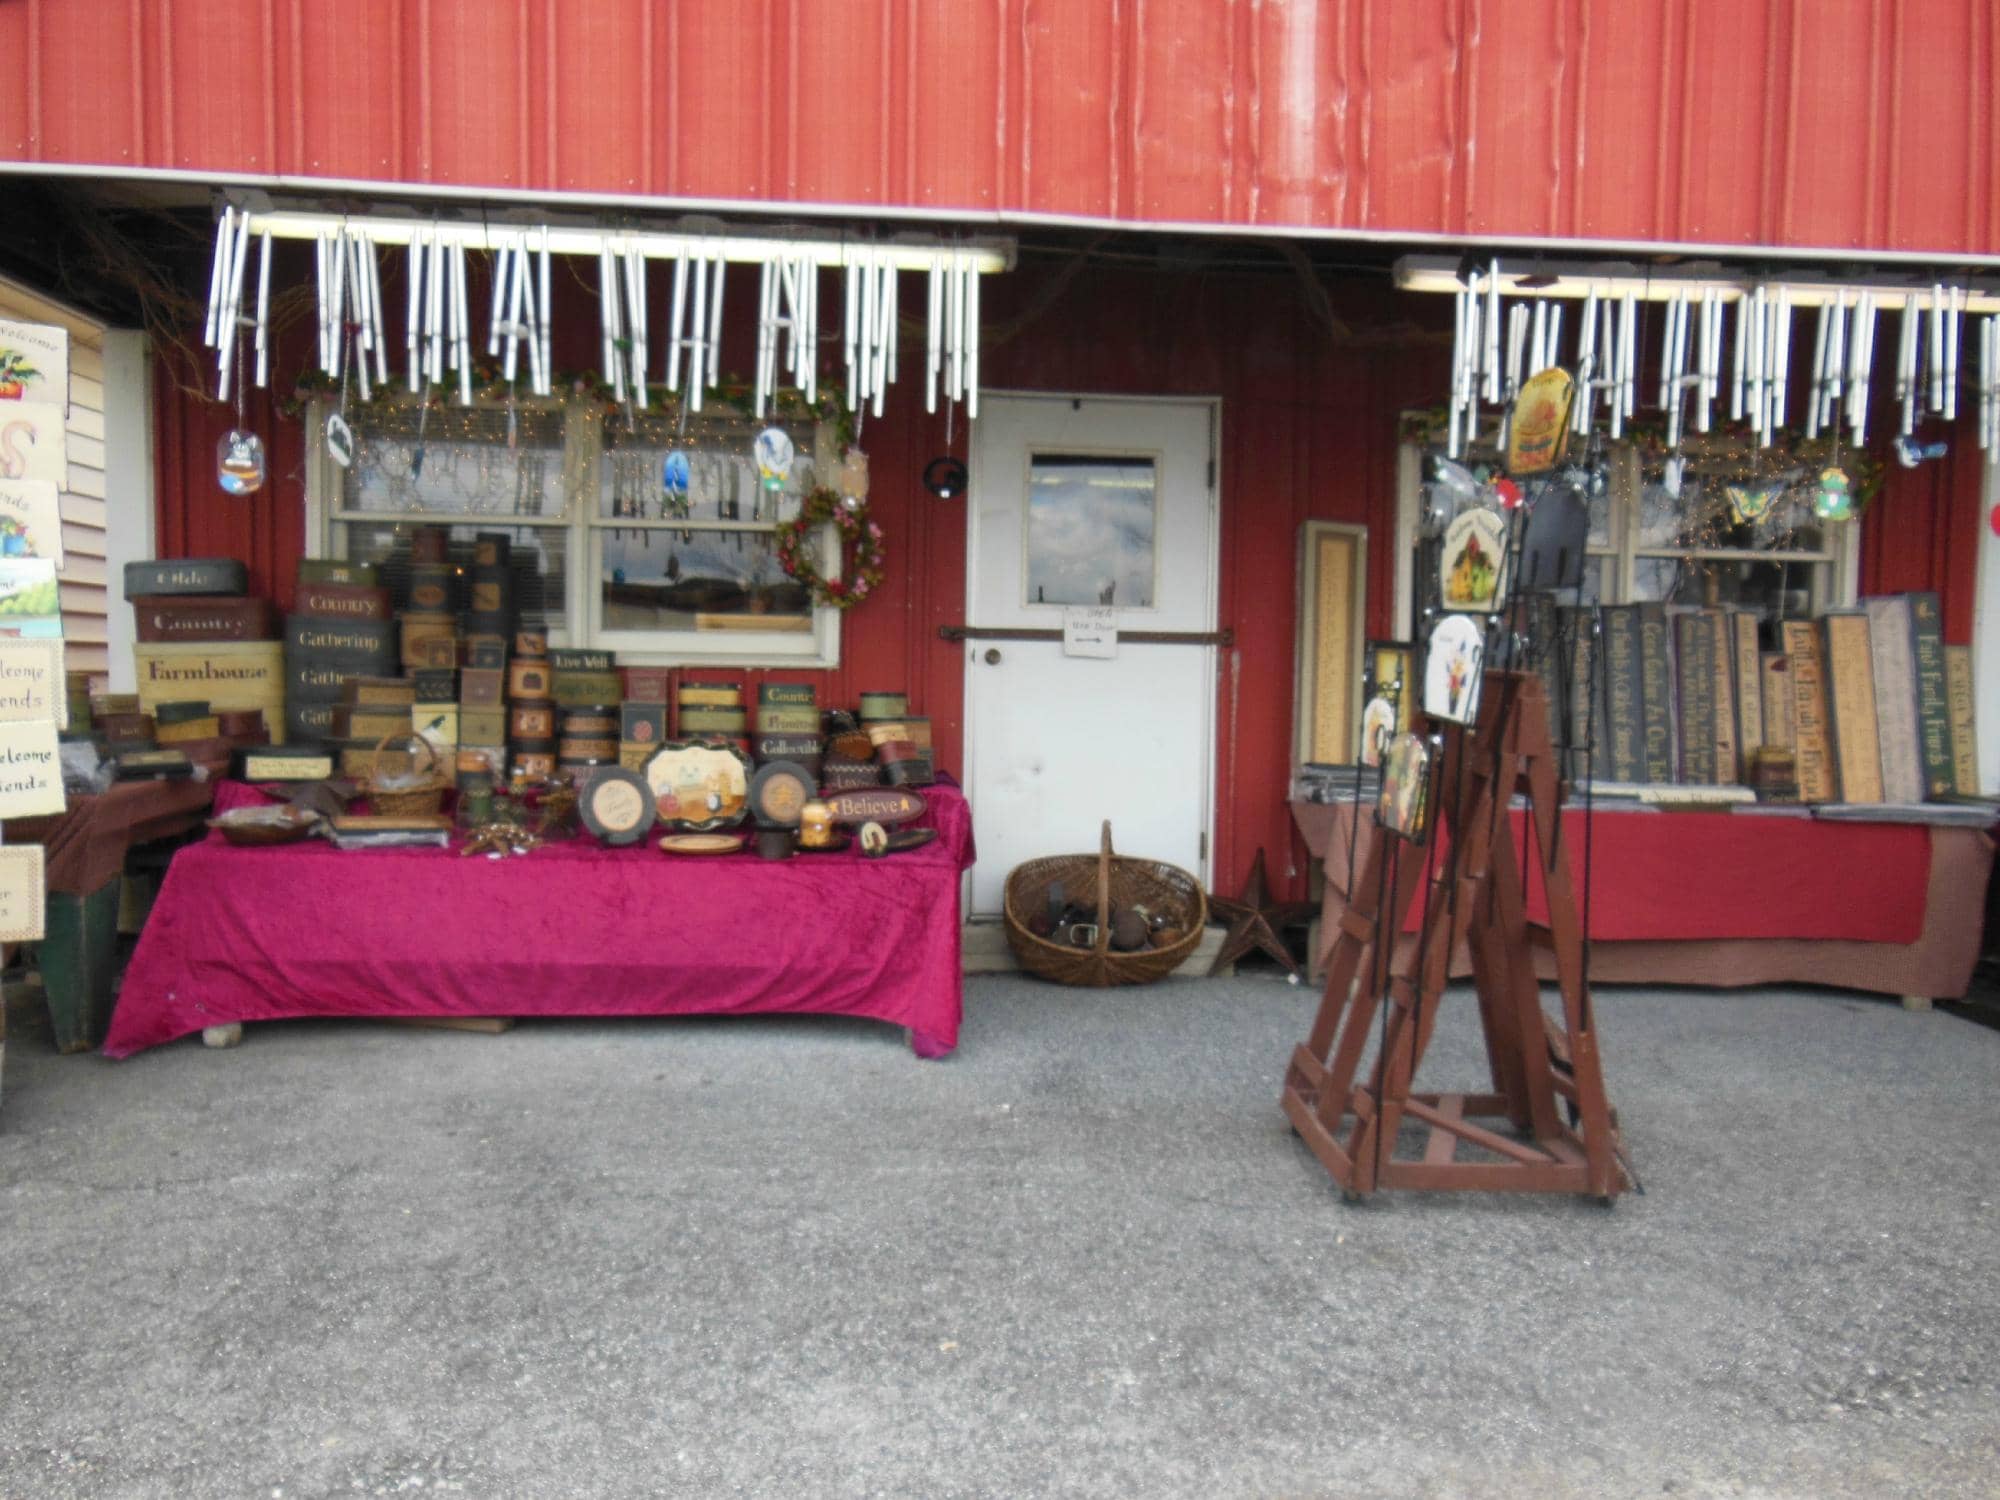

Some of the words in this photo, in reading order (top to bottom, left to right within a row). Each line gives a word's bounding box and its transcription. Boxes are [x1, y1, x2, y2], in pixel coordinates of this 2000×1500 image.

[309, 594, 378, 617] Country
[153, 614, 246, 636] Country
[299, 630, 380, 652] Gathering
[148, 659, 269, 681] Farmhouse
[555, 655, 581, 669] Live
[584, 655, 609, 669] Well
[1919, 672, 1944, 715] Family
[1925, 718, 1949, 767] Friends
[841, 797, 899, 817] Believe
